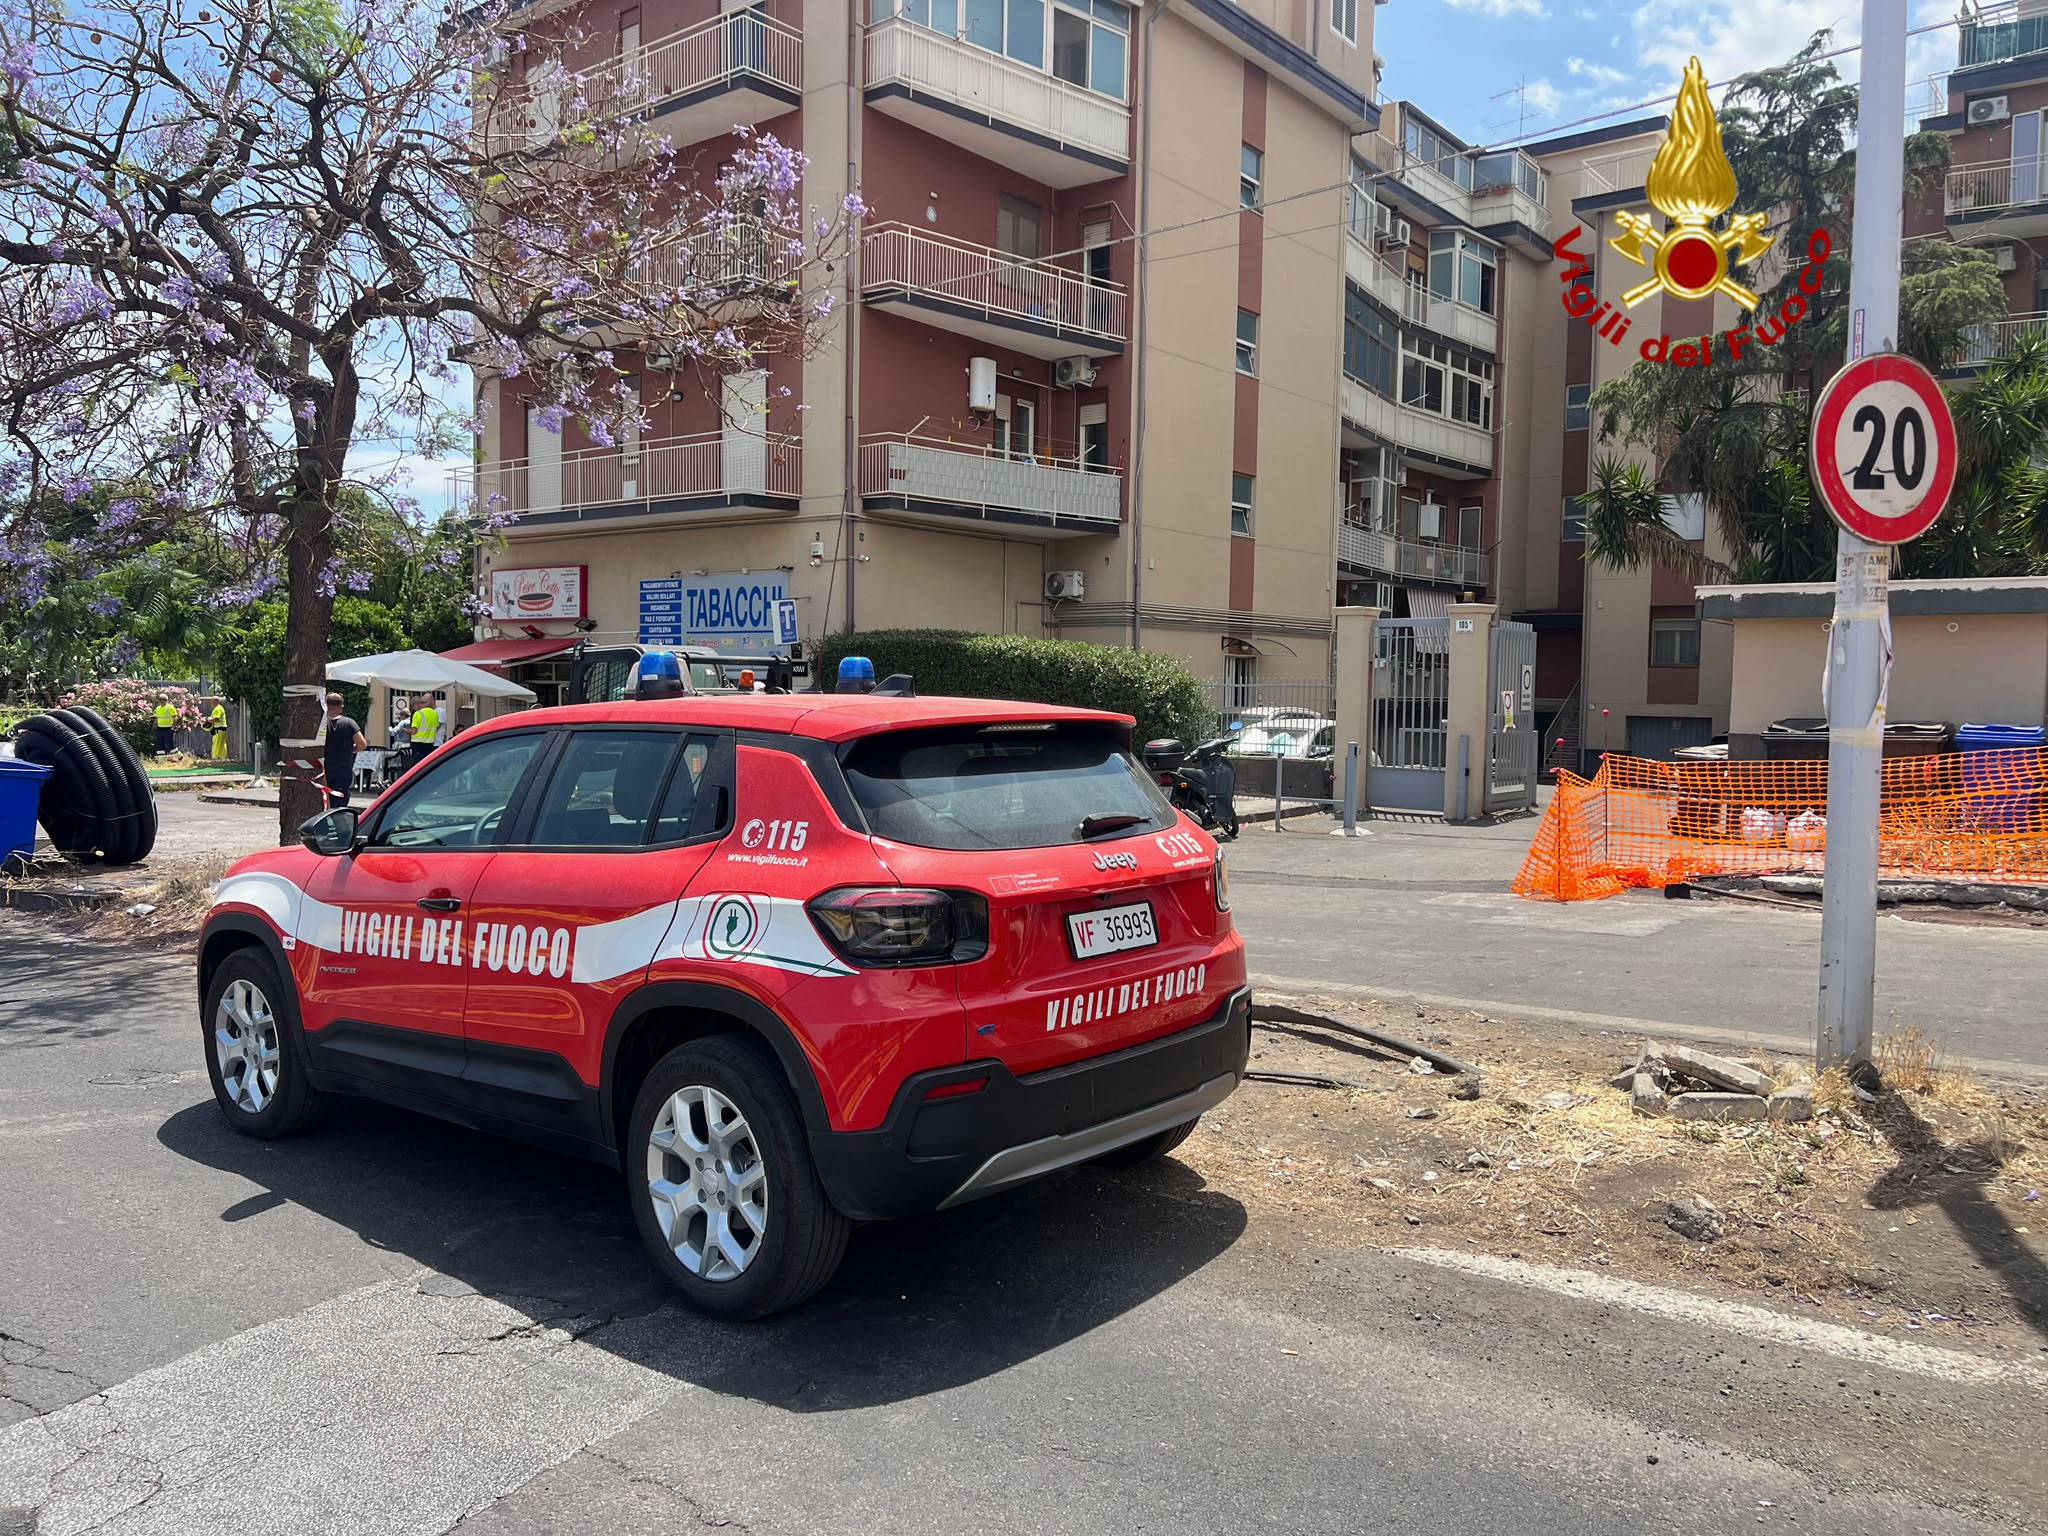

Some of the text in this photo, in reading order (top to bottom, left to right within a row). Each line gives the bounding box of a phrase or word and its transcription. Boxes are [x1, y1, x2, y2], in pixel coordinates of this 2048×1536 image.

[1853, 405, 1926, 490] 20
[767, 819, 809, 851] 115
[1168, 833, 1203, 855] 115
[727, 853, 809, 867] www.vigilfuoco.it
[1092, 851, 1138, 871] Jeep
[344, 911, 570, 978] VIGILI DEL FUOCO
[1075, 911, 1152, 949] VF 36993
[1046, 963, 1206, 1032] VIGILI DEL FUOCO
